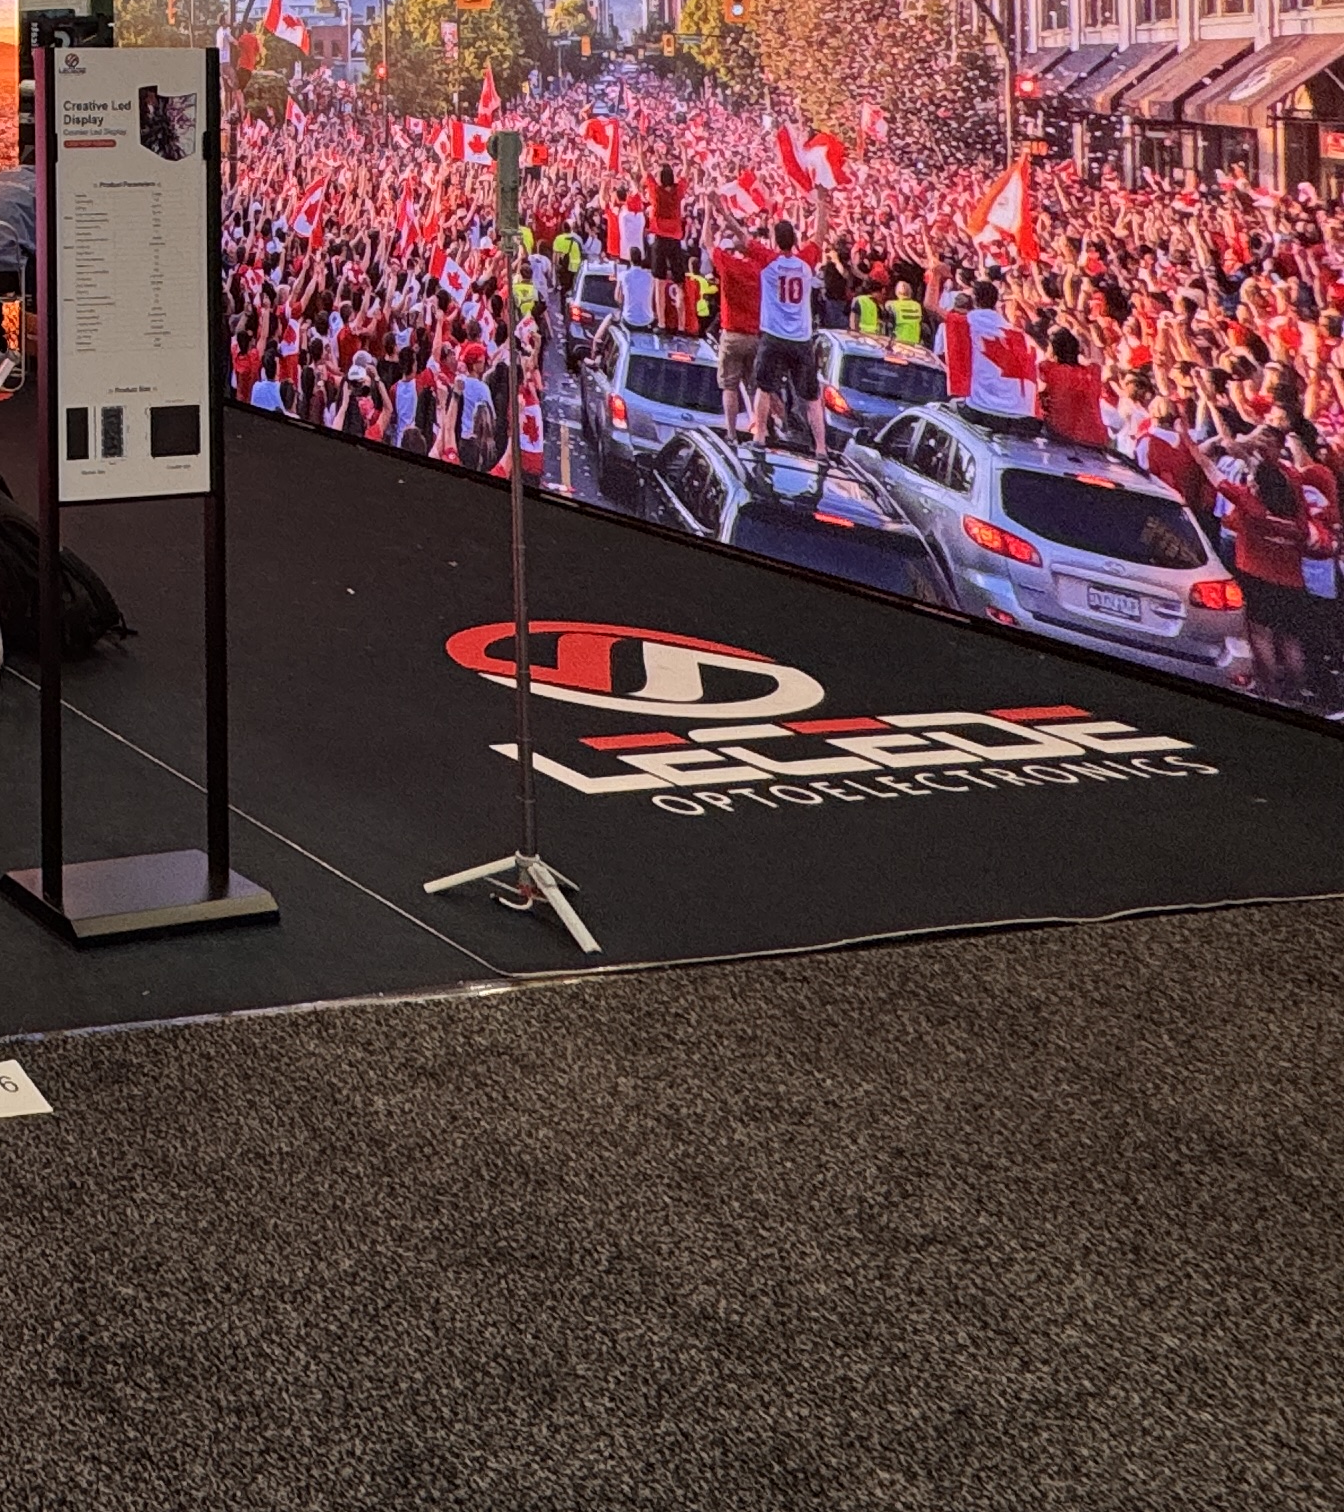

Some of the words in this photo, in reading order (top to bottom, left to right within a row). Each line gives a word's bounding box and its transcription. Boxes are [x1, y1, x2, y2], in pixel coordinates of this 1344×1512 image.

[63, 100, 108, 111] Creative
[111, 100, 132, 111] Led
[63, 114, 104, 127] Display
[778, 275, 804, 305] 10
[488, 705, 1200, 795] LECEDE
[651, 754, 1221, 817] OPTOELECTRONICS
